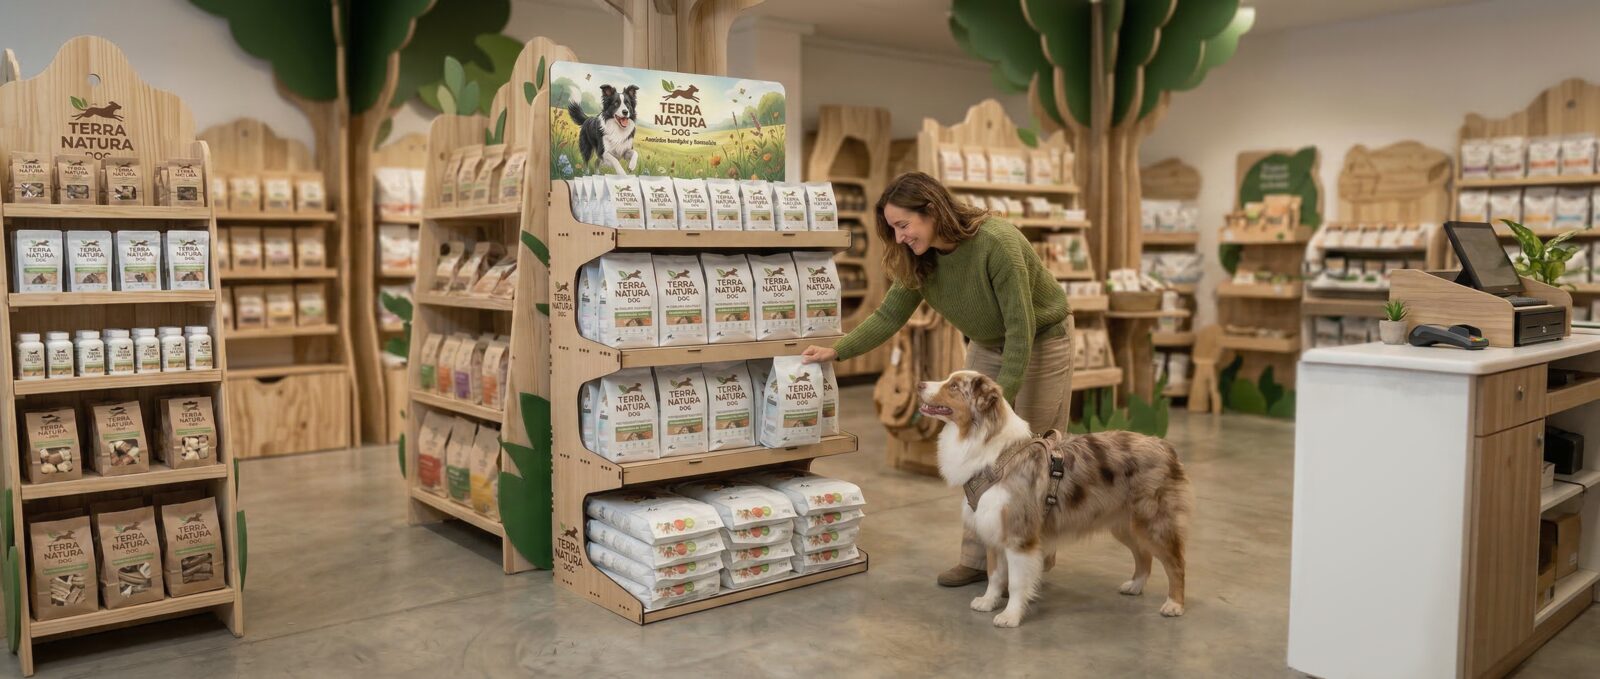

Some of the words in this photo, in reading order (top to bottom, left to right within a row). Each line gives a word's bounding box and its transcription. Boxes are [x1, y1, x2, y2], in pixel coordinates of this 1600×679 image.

[660, 102, 702, 116] TERRA
[654, 114, 707, 129] NATURA
[68, 122, 126, 137] TERRA
[672, 128, 690, 136] DOG
[61, 136, 134, 151] NATURA
[617, 281, 646, 289] TERRA
[615, 289, 650, 298] NATURA
[665, 288, 699, 296] NATURA
[553, 293, 571, 302] TERRA
[552, 302, 573, 311] NATURA
[716, 384, 743, 394] TERRA
[788, 384, 814, 392] TERRA
[668, 389, 697, 398] TERRA
[715, 392, 747, 401] NATURA
[785, 391, 818, 400] NATURA
[618, 394, 646, 404] TERRA
[667, 397, 701, 406] NATURA
[615, 402, 651, 412] NATURA
[178, 523, 208, 534] TERRA
[114, 531, 145, 543] TERRA
[176, 530, 212, 542] NATURA
[47, 541, 80, 552] TERRA
[112, 539, 150, 551] NATURA
[557, 537, 581, 555] TERRA
[44, 549, 84, 560] NATURA
[555, 548, 583, 568] NATURA
